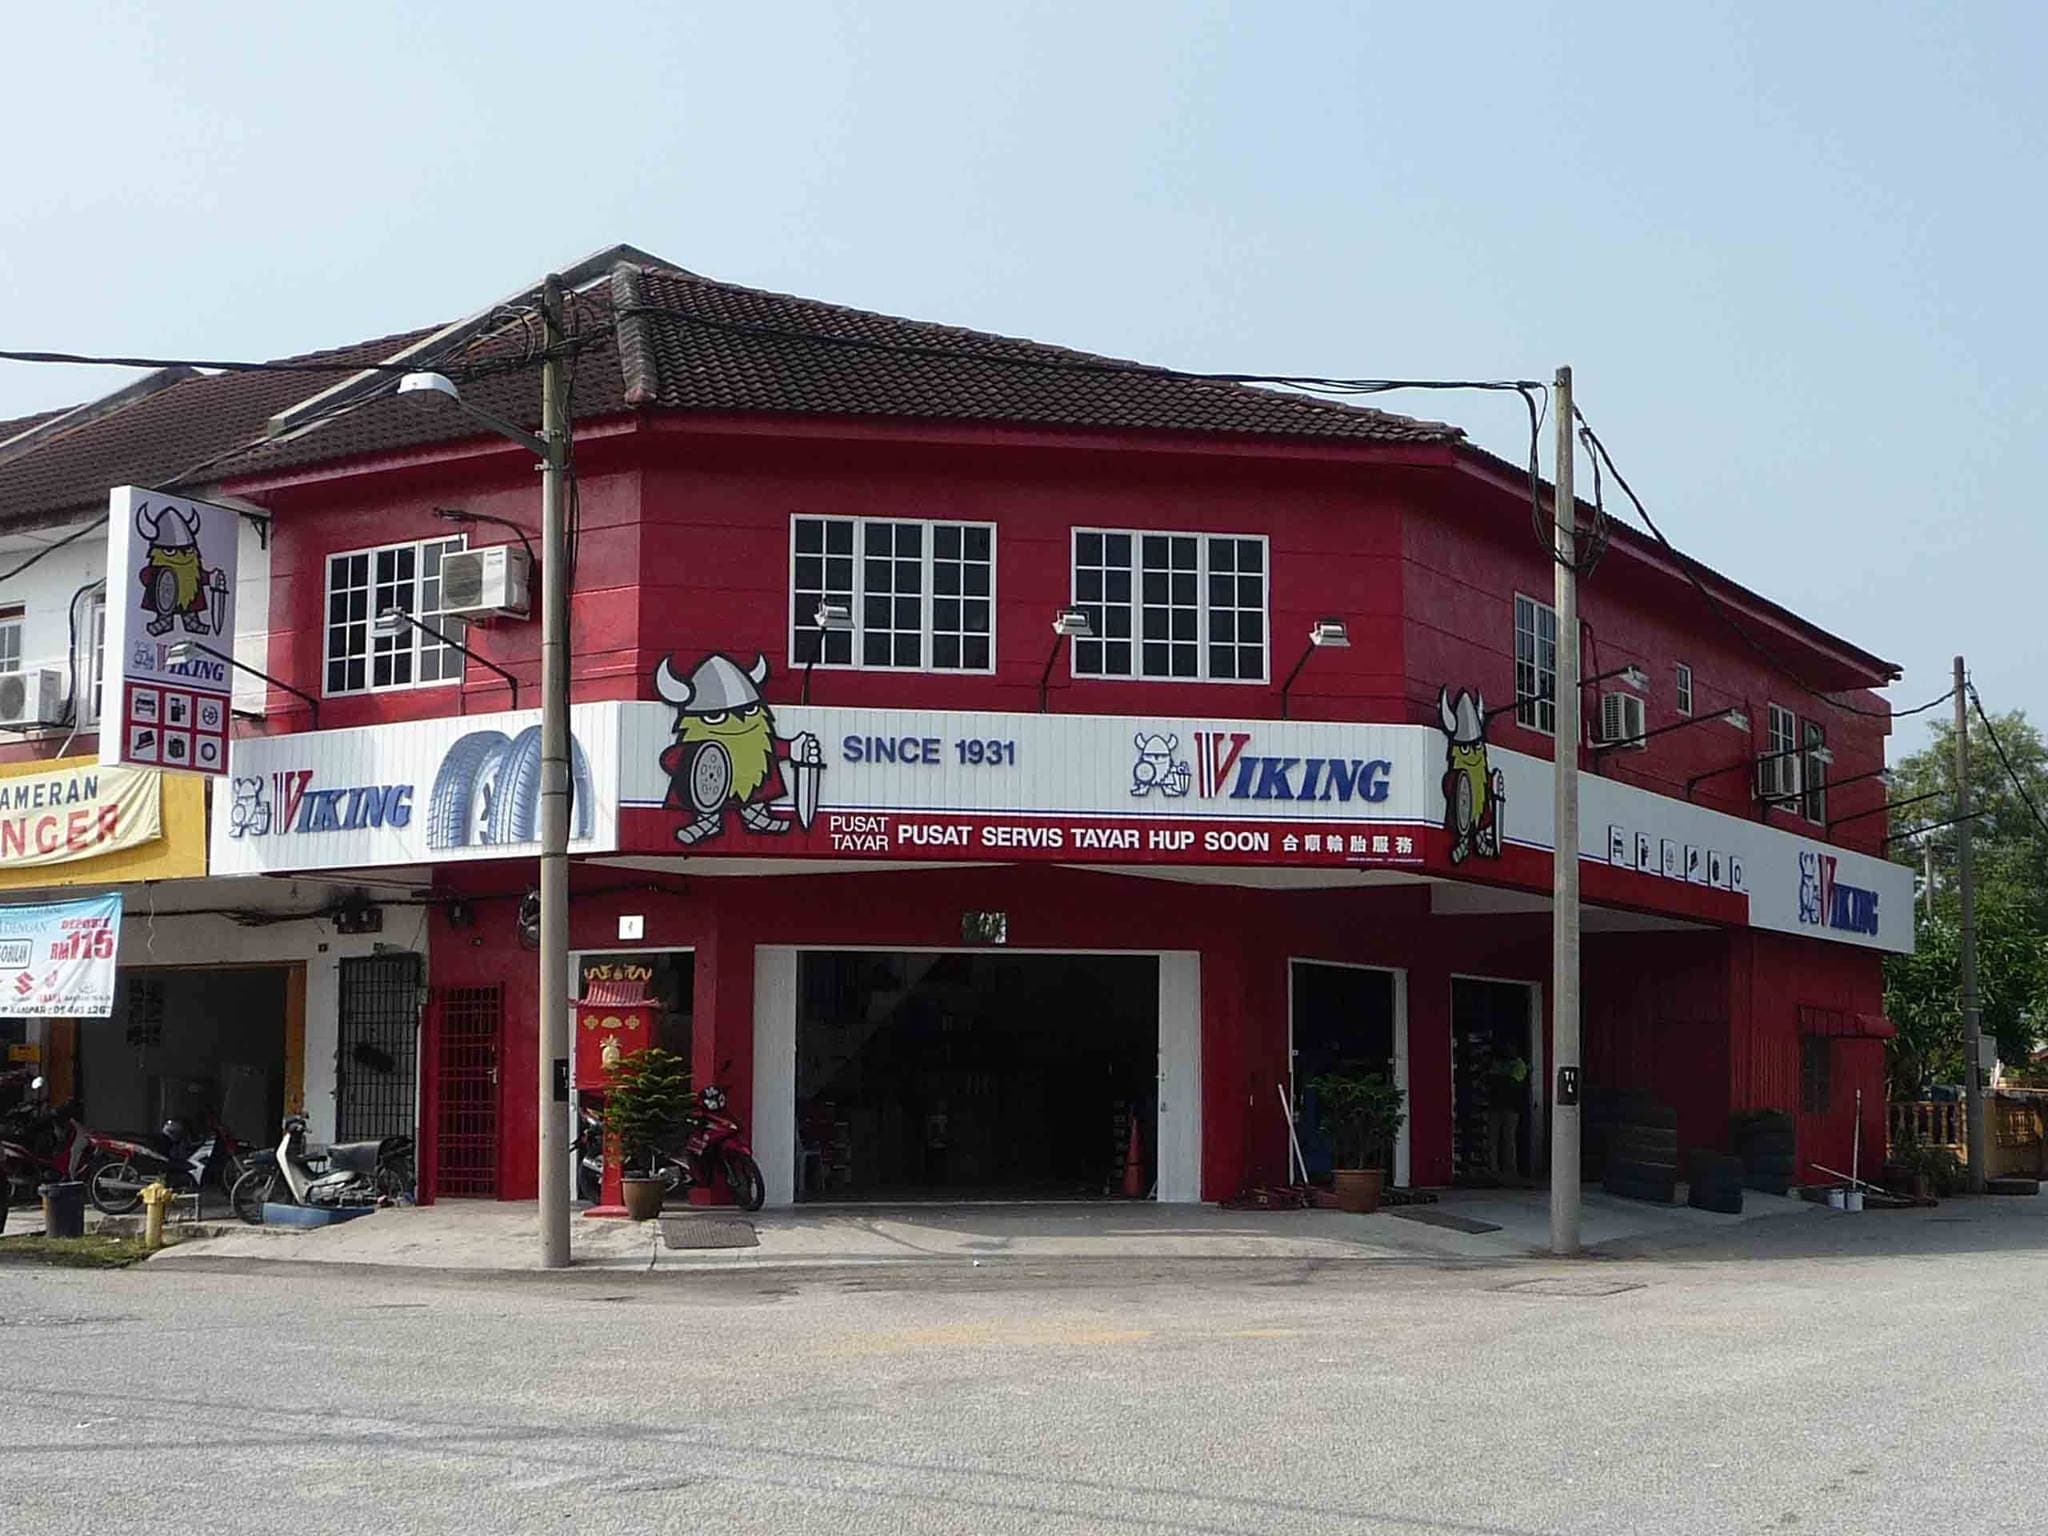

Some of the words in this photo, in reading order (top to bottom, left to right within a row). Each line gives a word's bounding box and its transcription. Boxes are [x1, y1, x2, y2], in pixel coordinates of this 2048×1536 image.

[842, 735, 941, 765] SINCE
[954, 738, 1015, 766] 1931
[1193, 732, 1392, 803] VIKING
[272, 769, 414, 836] VIKING
[830, 816, 889, 833] PUSAT
[897, 824, 973, 846] PUSAT
[981, 826, 1064, 848] SERVIS
[1070, 828, 1140, 849] TAYAR
[1149, 830, 1195, 850] HUP
[1204, 831, 1270, 852] SOON
[830, 834, 889, 851] TAYAR
[50, 929, 114, 960] RM115
